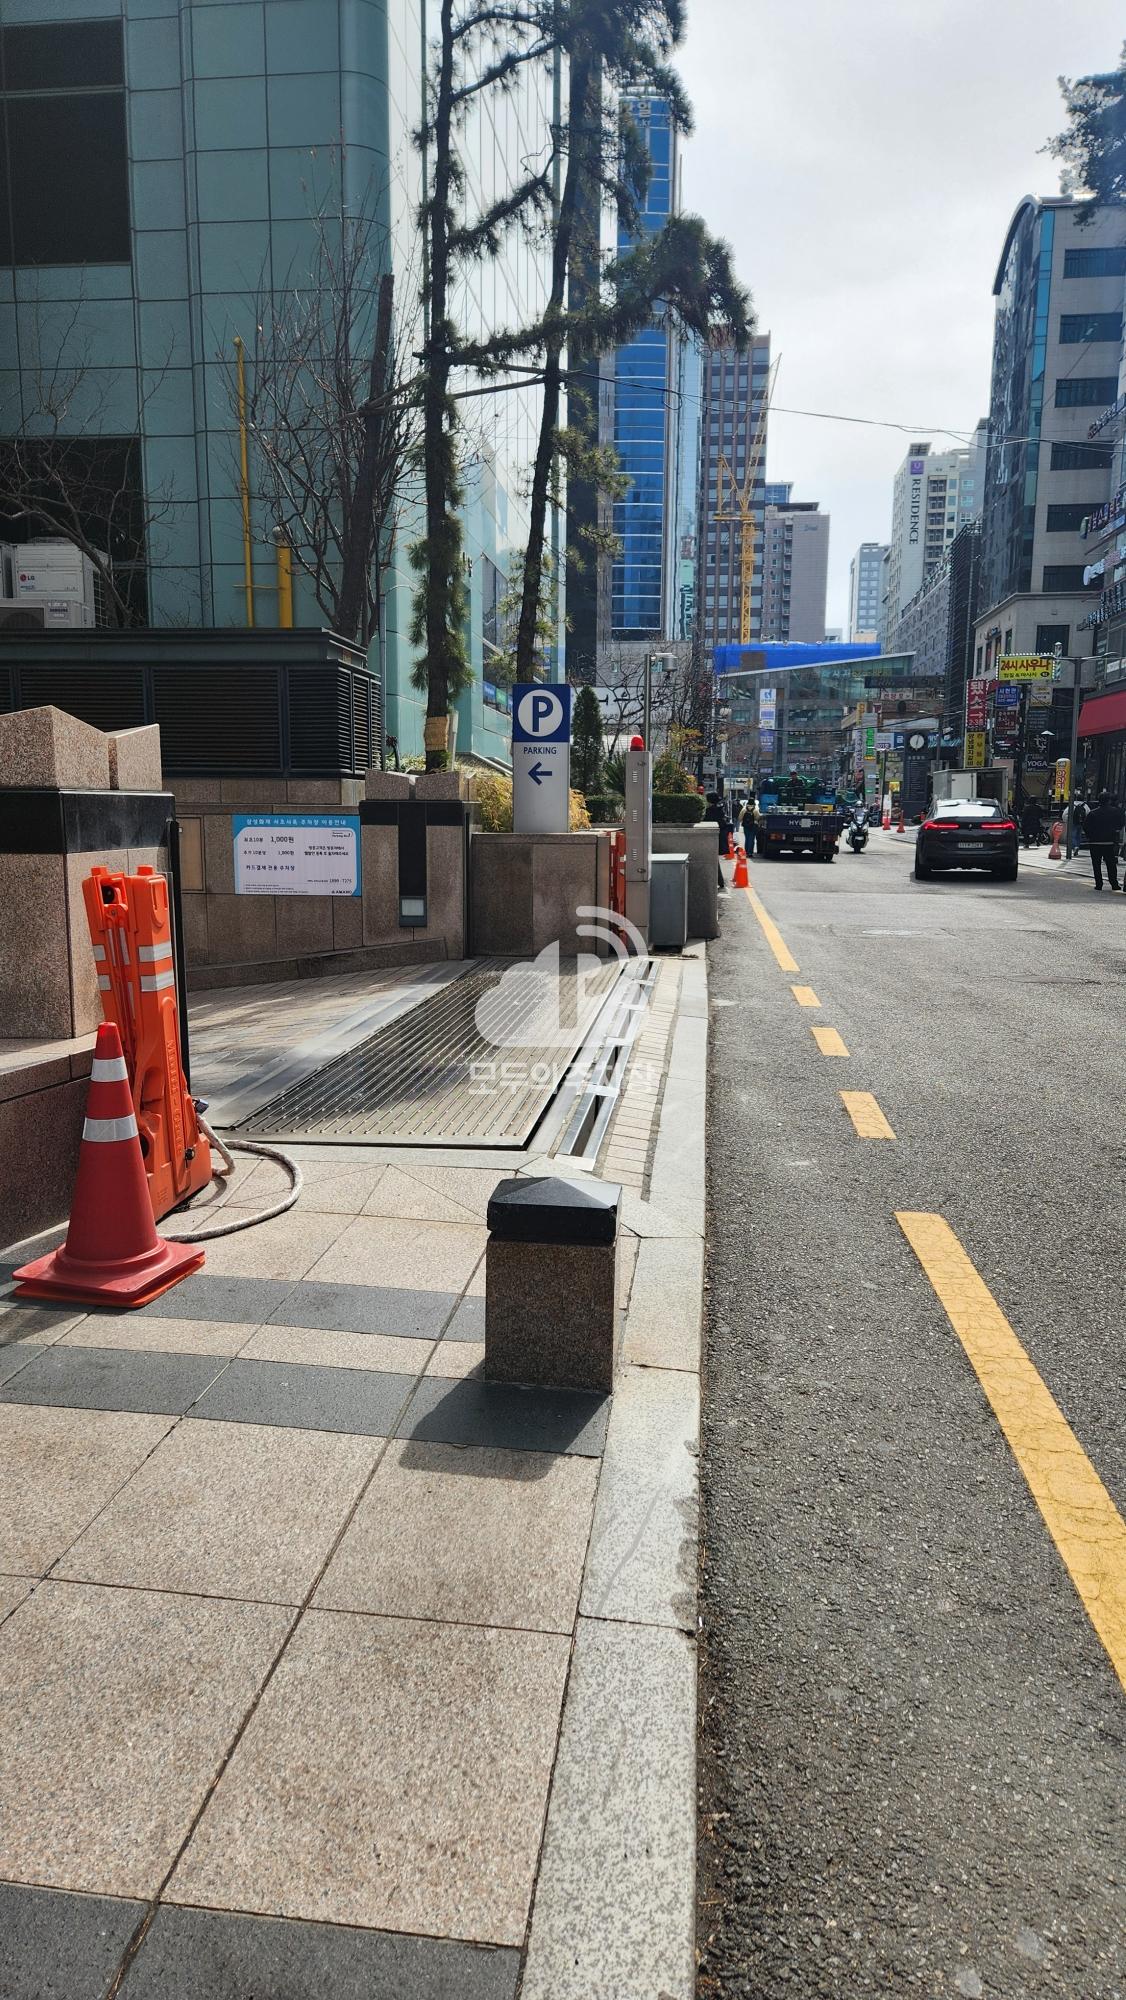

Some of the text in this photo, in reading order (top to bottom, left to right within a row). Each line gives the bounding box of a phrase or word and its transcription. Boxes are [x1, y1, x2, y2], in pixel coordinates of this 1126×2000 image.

[909, 478, 921, 545] RESIDENCE
[1000, 659, 1051, 671] 24시 사우나
[532, 695, 554, 732] P
[523, 746, 557, 755] PARKING
[271, 836, 295, 844] 1,000원
